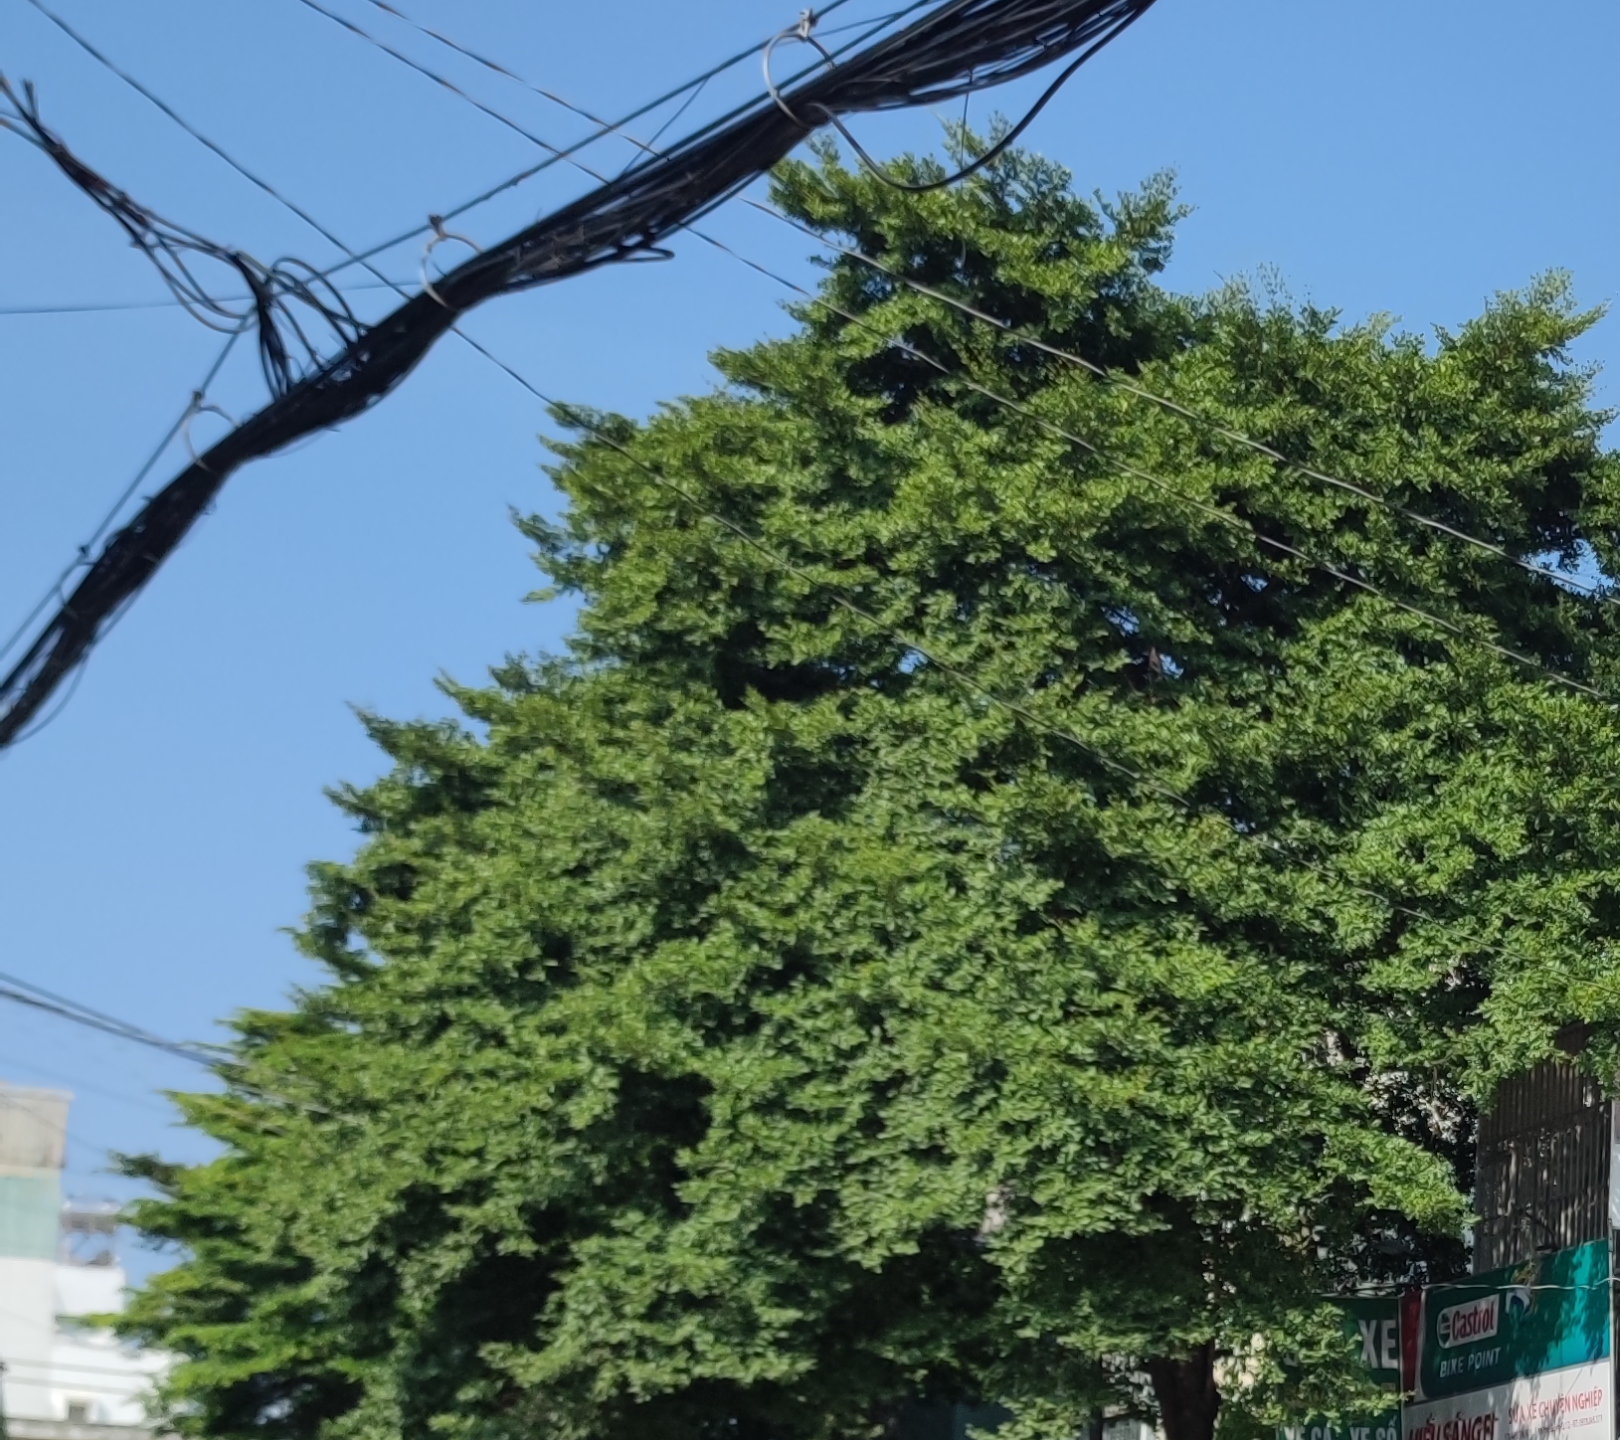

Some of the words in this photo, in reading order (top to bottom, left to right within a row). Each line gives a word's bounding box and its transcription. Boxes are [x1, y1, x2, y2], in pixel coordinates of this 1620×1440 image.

[1452, 1300, 1495, 1342] Castrol
[1356, 1319, 1399, 1370] XE
[1439, 1356, 1464, 1378] BIKE
[1467, 1346, 1501, 1372] POINT
